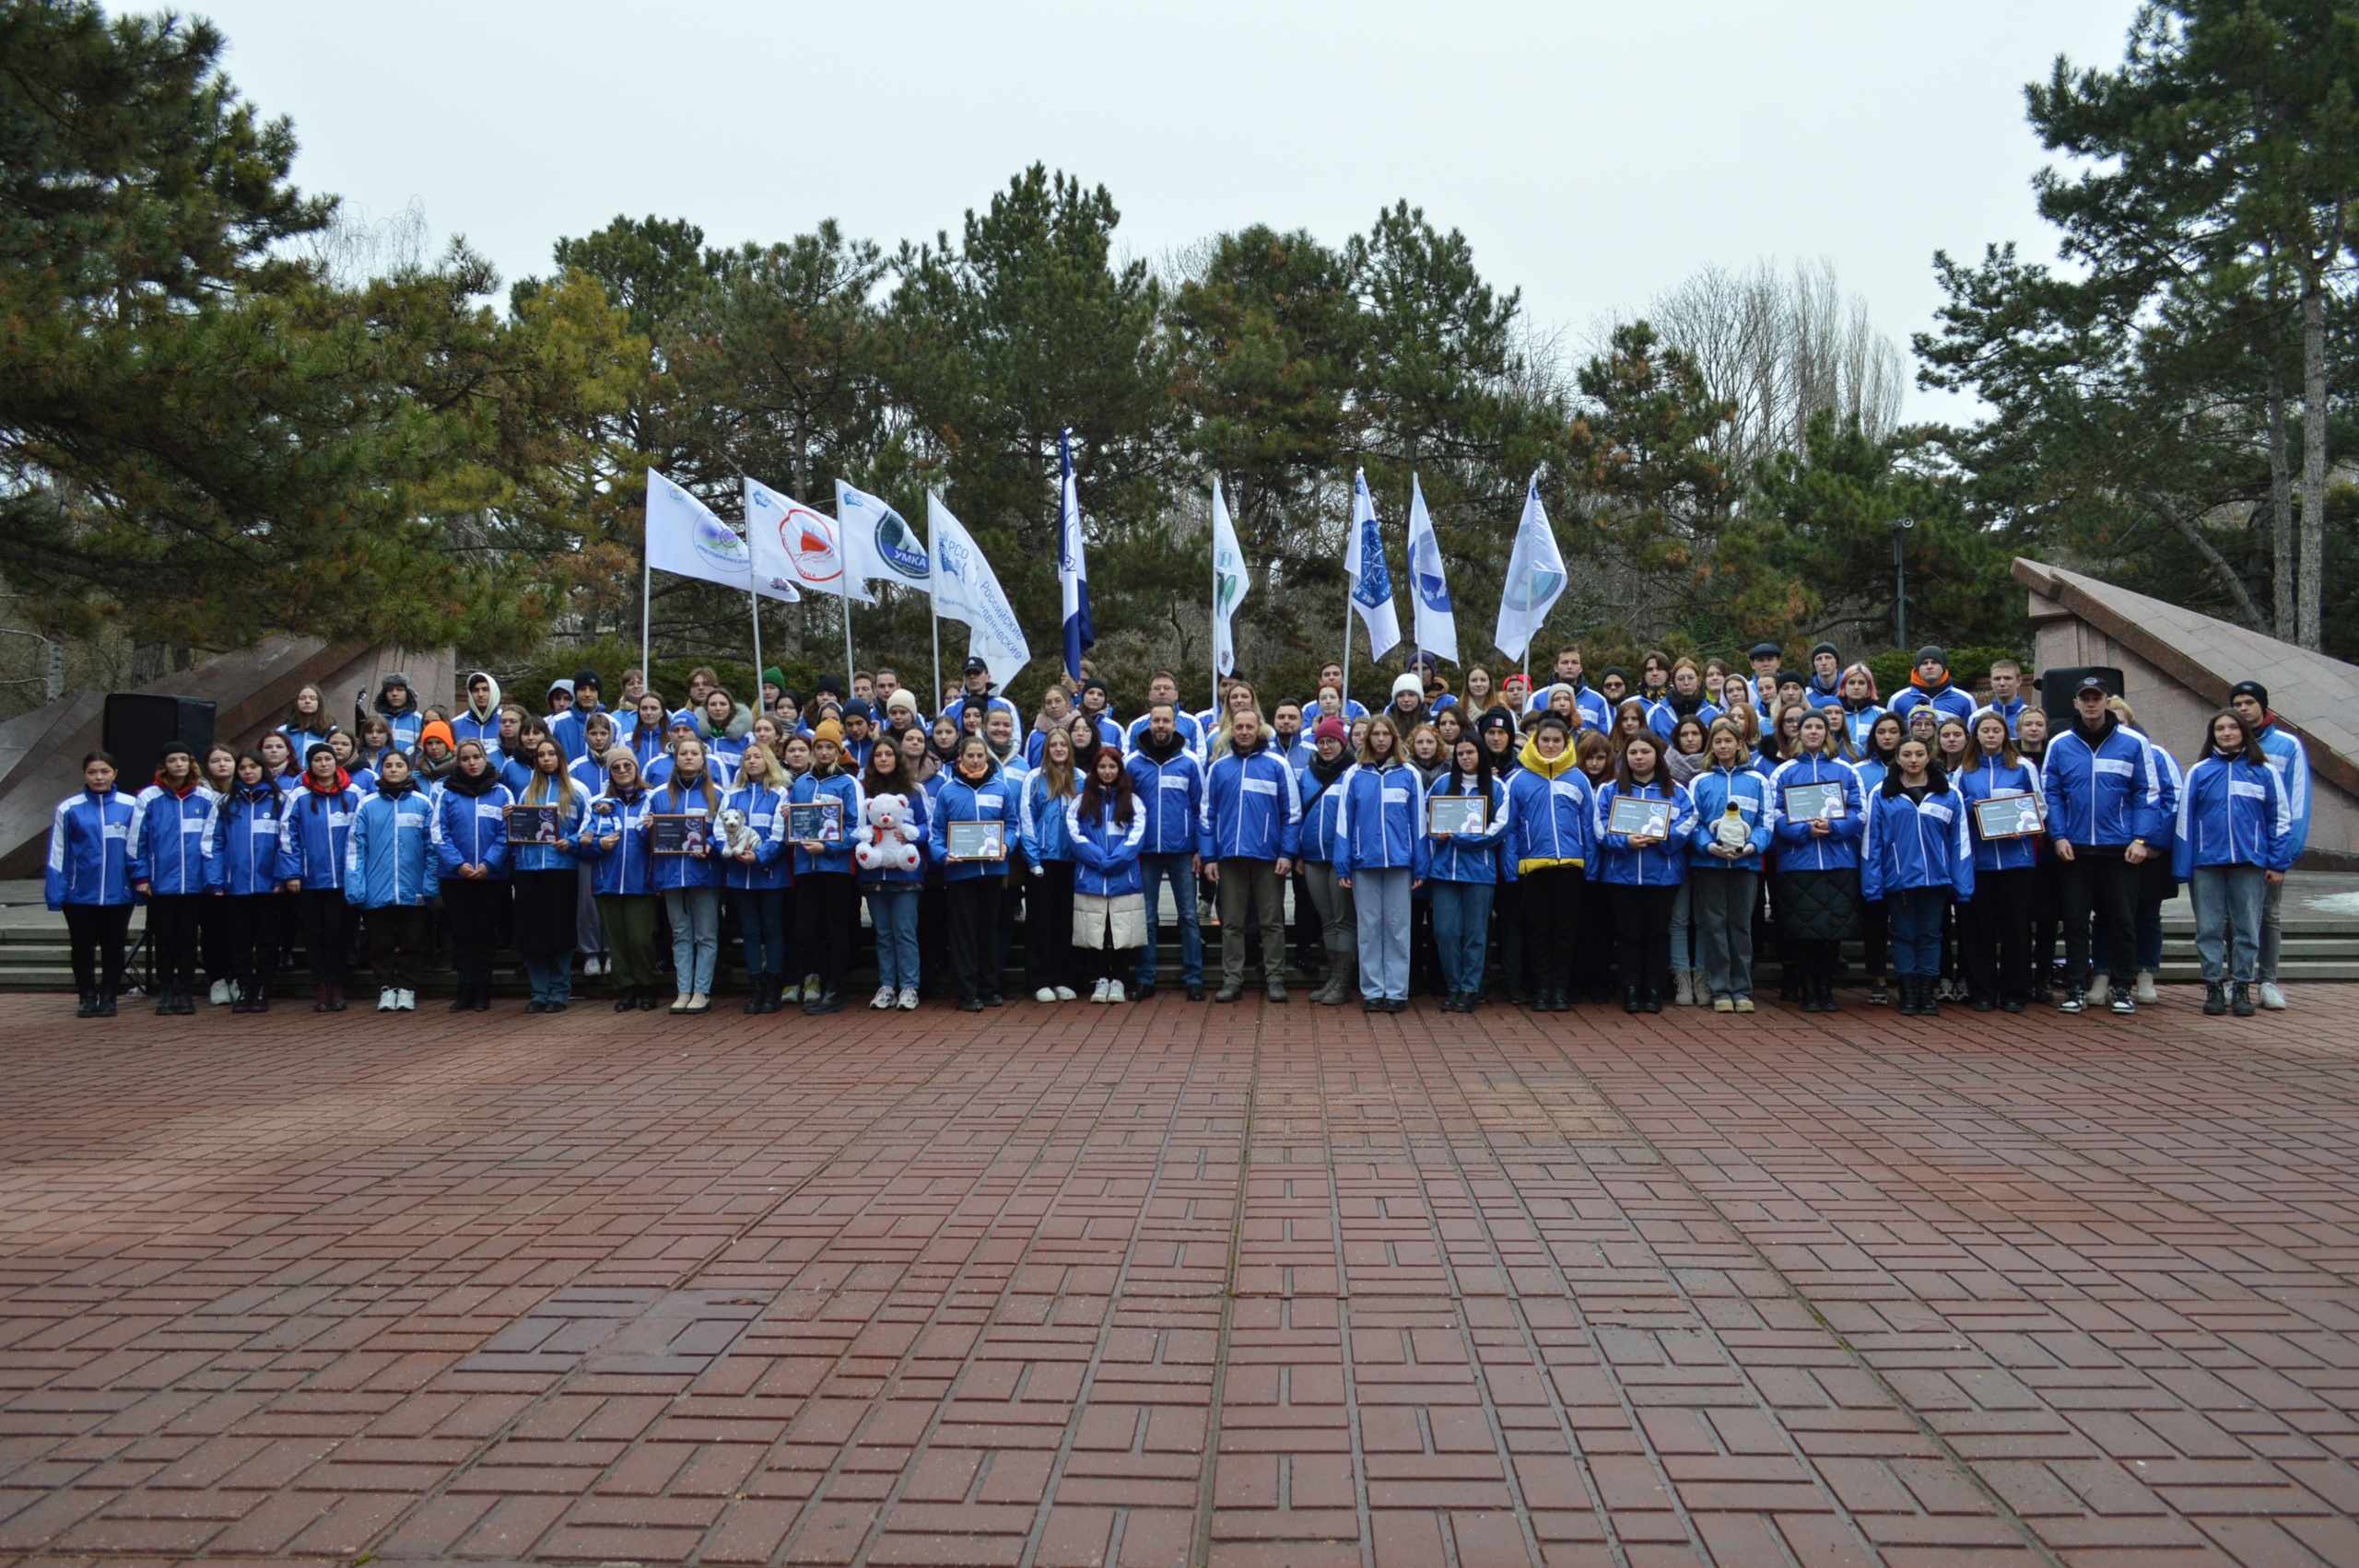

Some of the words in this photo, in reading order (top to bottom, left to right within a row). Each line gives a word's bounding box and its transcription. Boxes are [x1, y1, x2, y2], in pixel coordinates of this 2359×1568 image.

[894, 550, 927, 568] УМКА
[948, 540, 969, 559] РСО
[980, 580, 1024, 641] Российские
